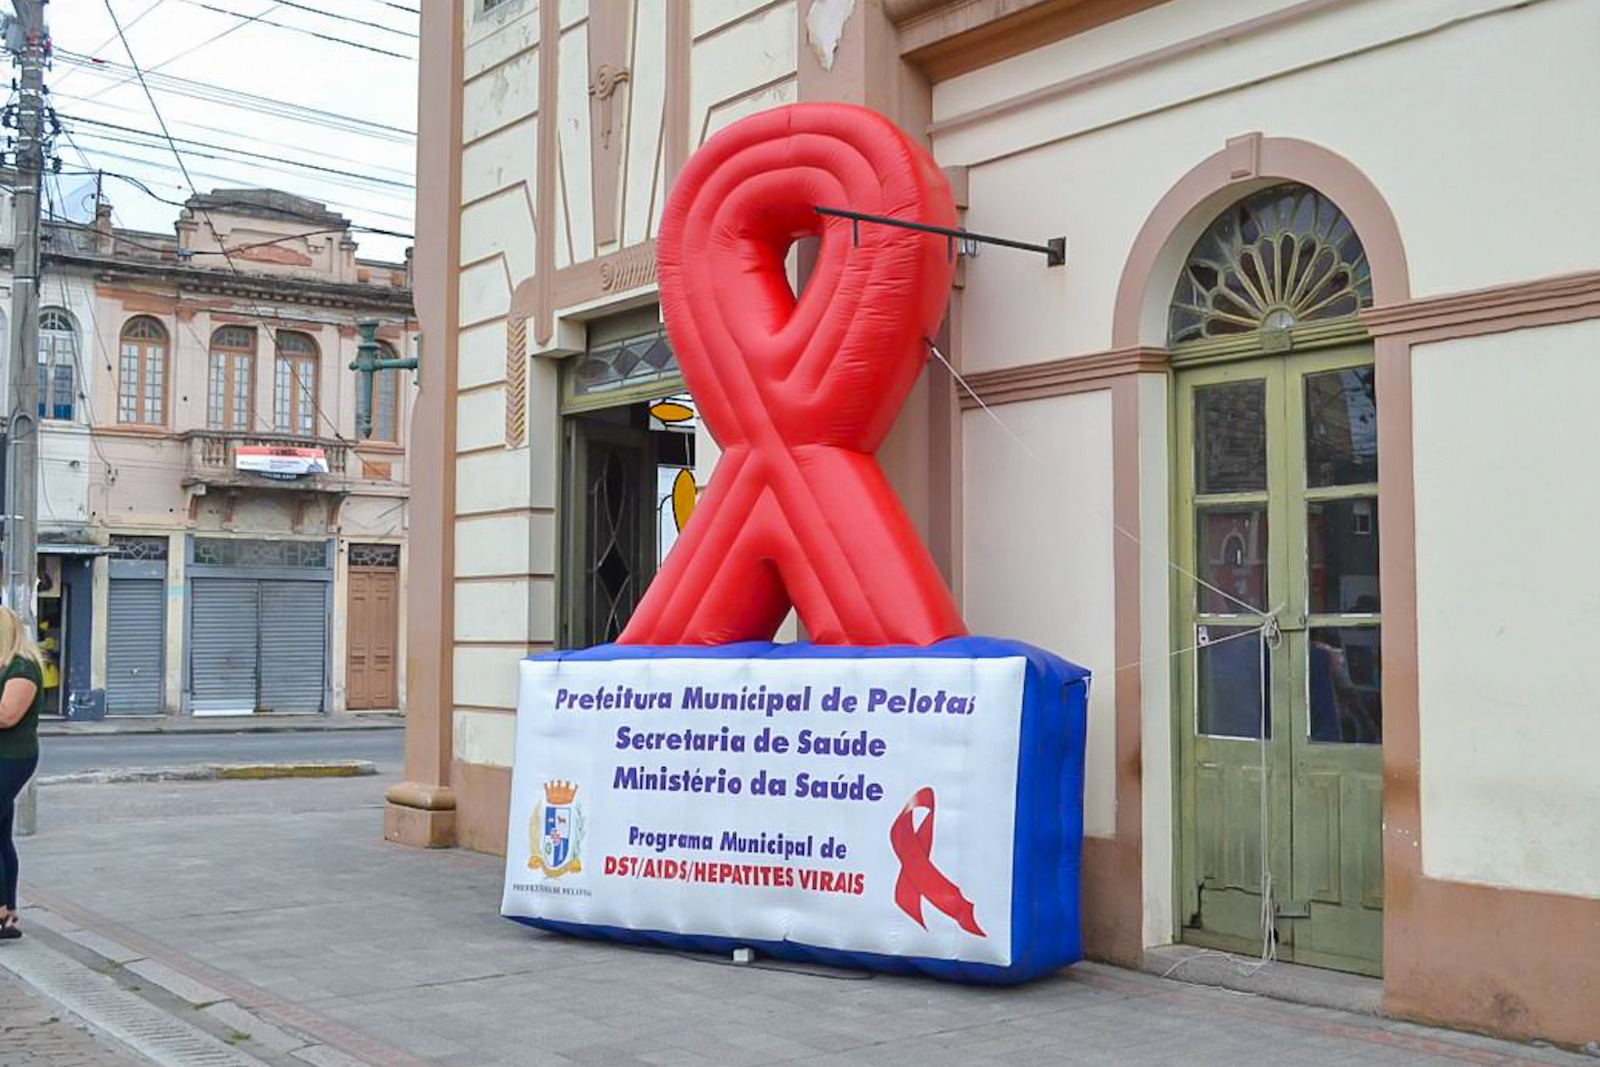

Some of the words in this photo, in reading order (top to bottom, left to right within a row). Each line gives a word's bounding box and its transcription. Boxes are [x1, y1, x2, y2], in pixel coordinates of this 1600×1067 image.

[555, 685, 673, 711] Prefeitura
[681, 685, 812, 718] Municipal
[821, 686, 858, 714] de
[615, 726, 746, 752] Secretaria
[753, 727, 790, 754] de
[796, 729, 887, 758] Saúde
[614, 766, 742, 795] Ministério
[750, 769, 787, 797] da
[794, 772, 884, 802] Saúde
[628, 826, 714, 854] Programa
[719, 831, 813, 861] Municipal
[819, 836, 847, 860] de
[604, 855, 796, 888] DST/AIDS/HEPATITES
[797, 868, 865, 896] VIRAIS
